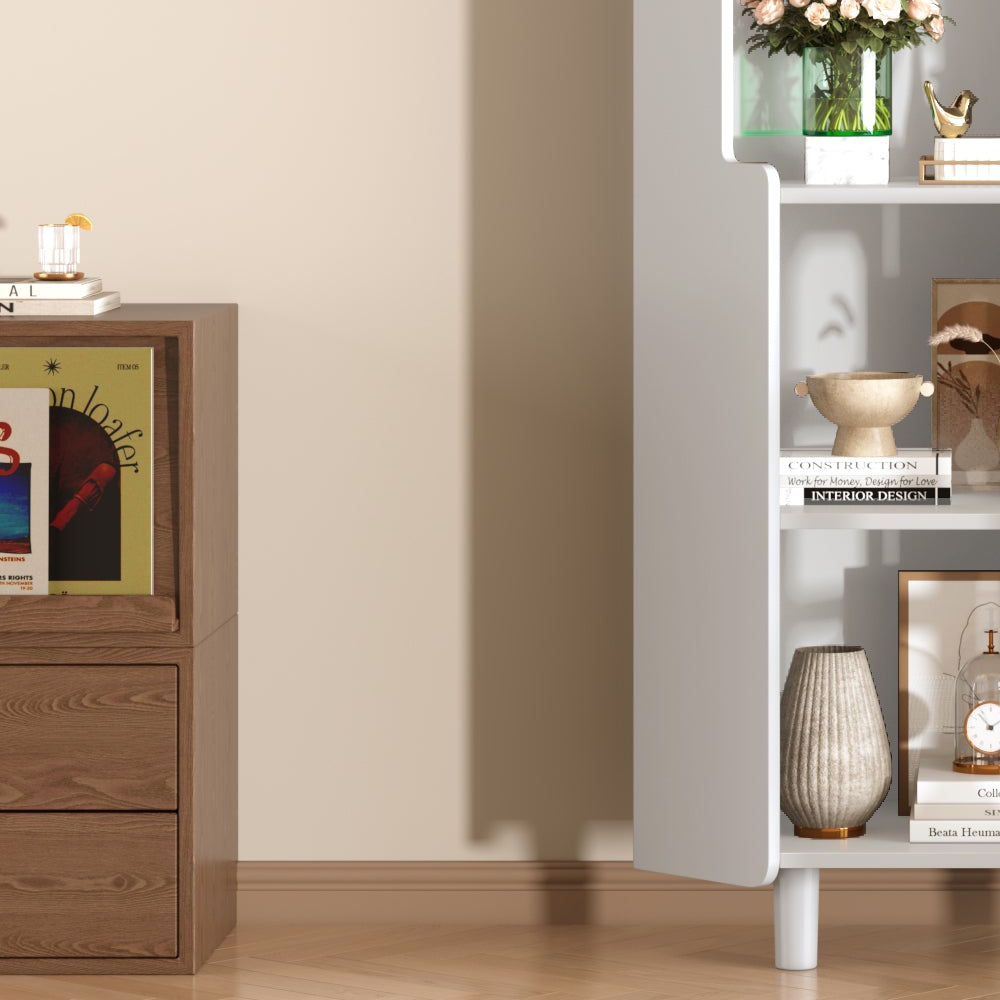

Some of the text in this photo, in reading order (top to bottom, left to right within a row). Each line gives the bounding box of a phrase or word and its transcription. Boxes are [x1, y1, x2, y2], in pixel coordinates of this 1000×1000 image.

[83, 385, 143, 474] loafer
[788, 461, 918, 470] CONSTRUCTION
[788, 476, 938, 489] Work for Money, Design for Love
[811, 491, 927, 501] INTERIOR DESIGN
[928, 827, 958, 837] Beata
